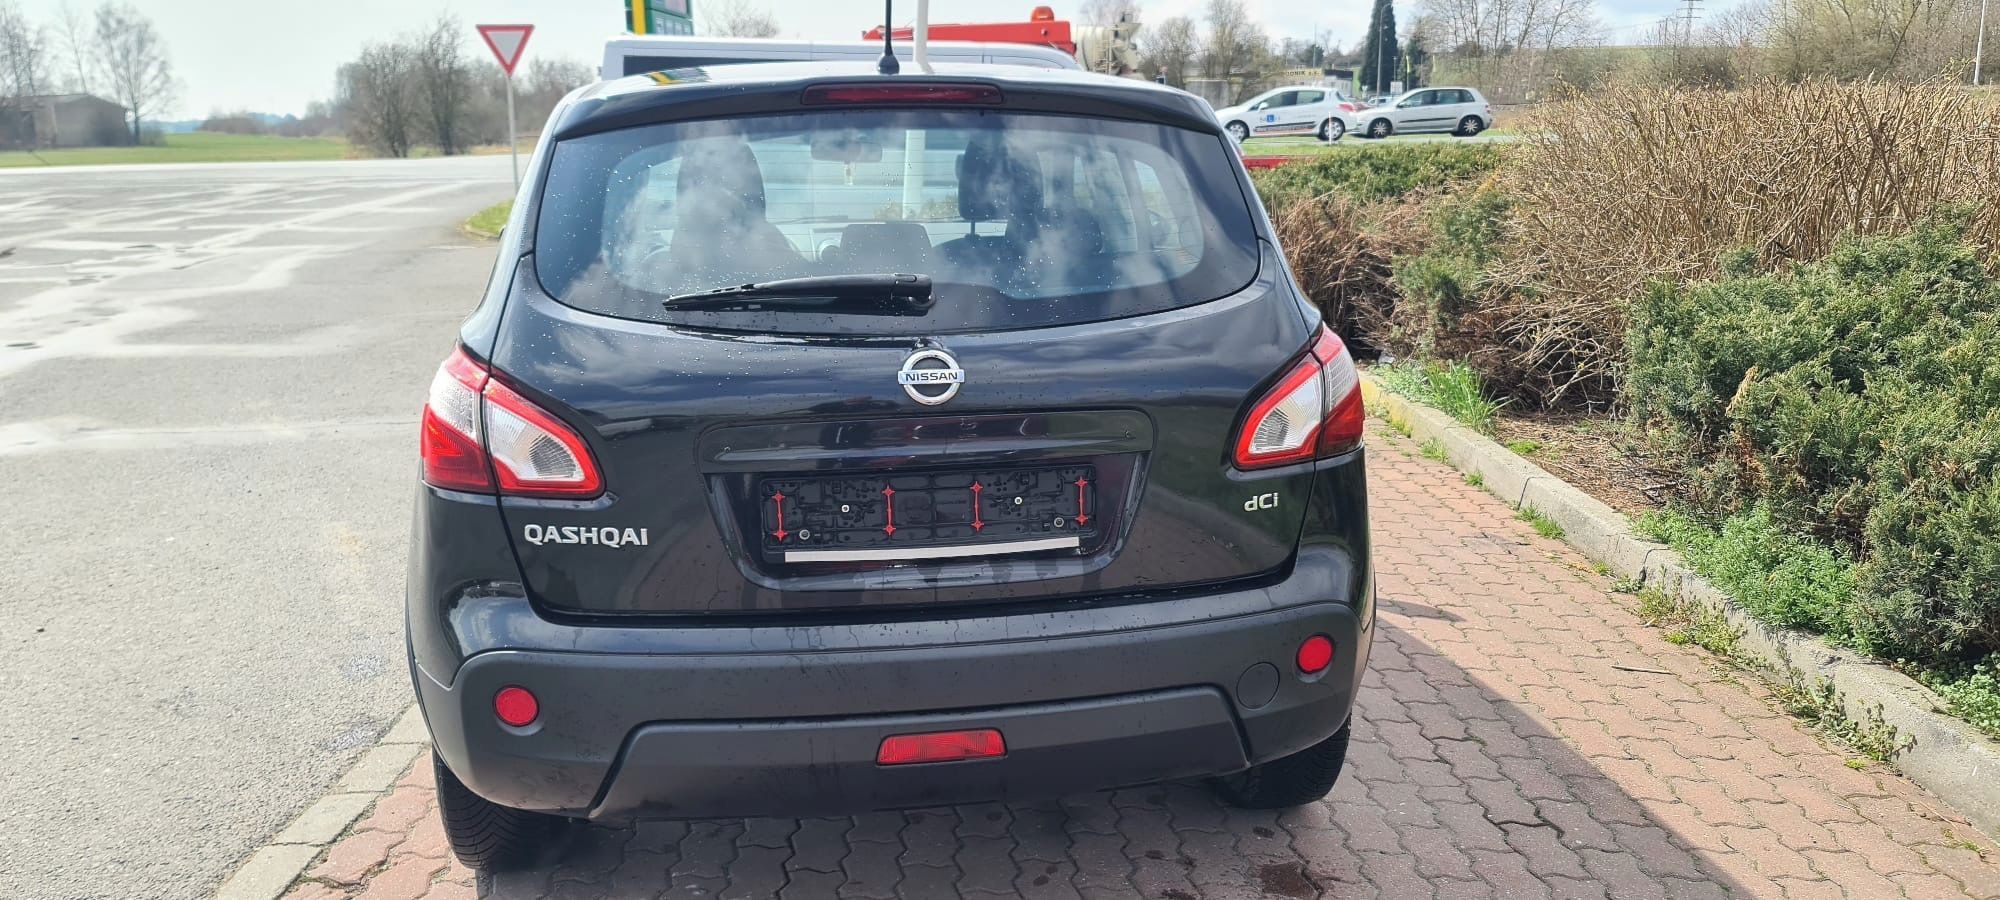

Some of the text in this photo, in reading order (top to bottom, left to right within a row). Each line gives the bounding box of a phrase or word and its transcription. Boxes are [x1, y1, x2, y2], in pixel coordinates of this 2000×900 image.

[905, 372, 958, 382] NISSAN
[1244, 492, 1279, 511] dCi
[524, 524, 648, 548] QASHQAI
